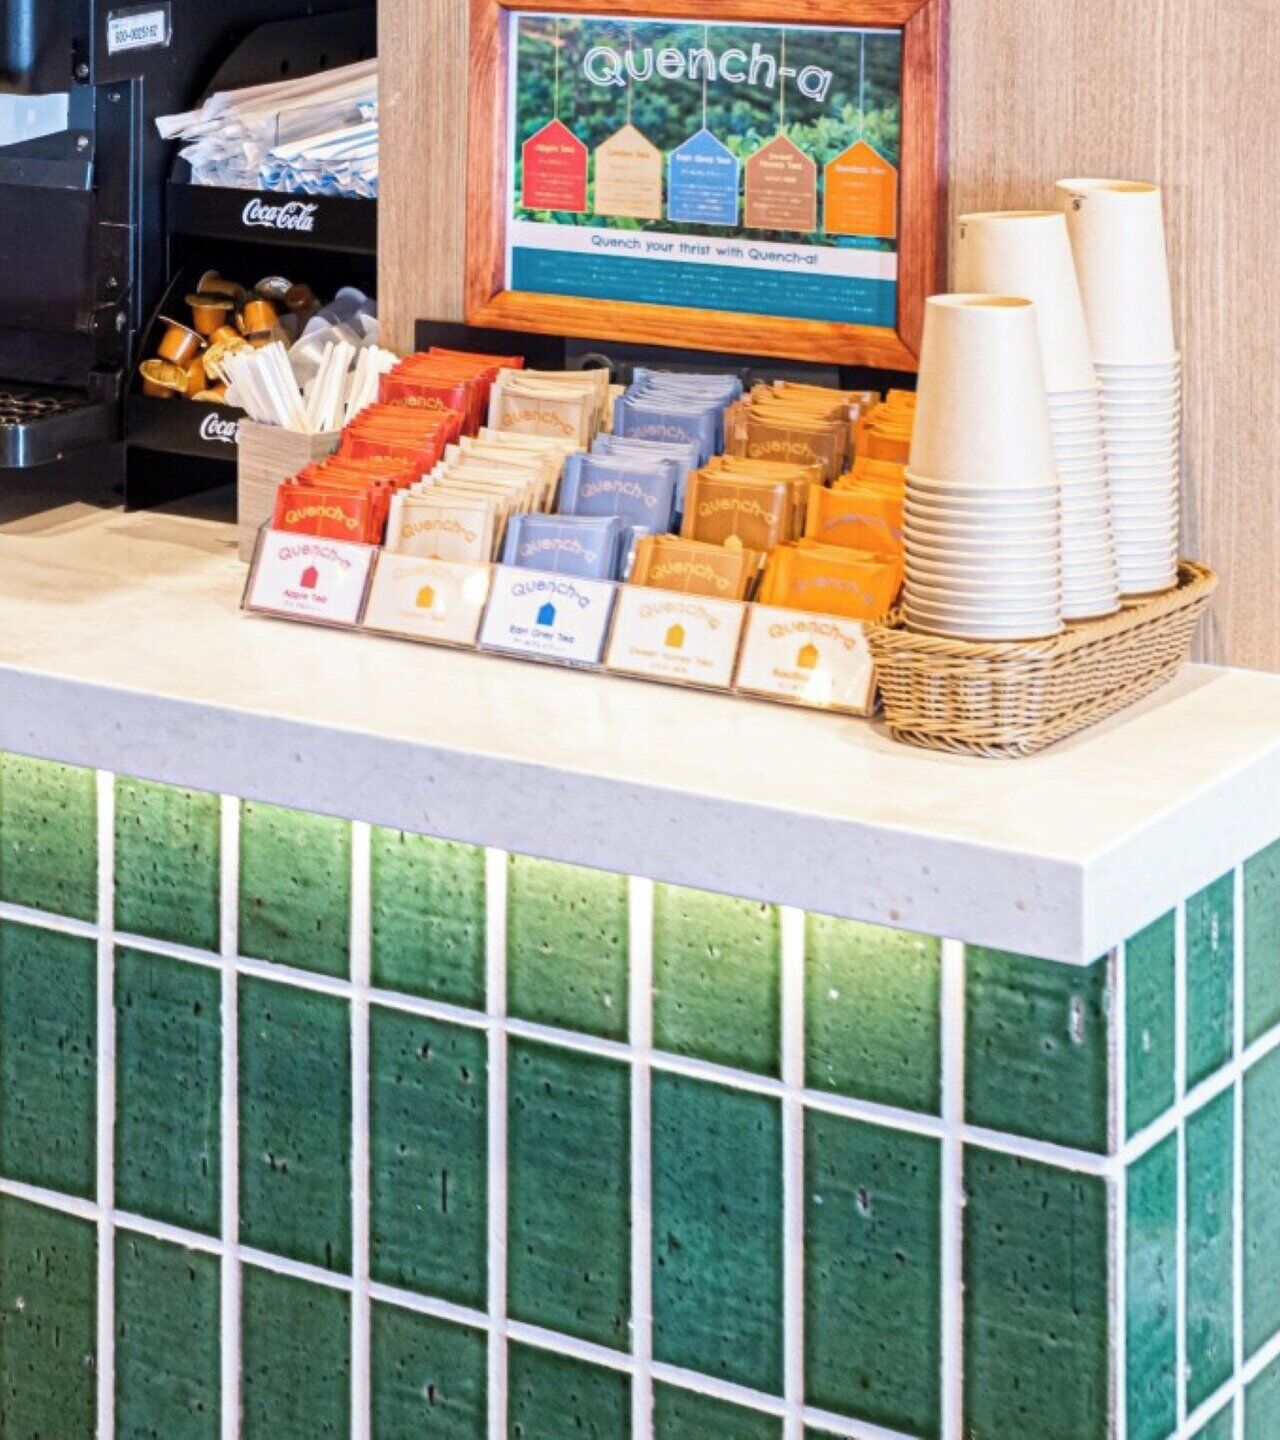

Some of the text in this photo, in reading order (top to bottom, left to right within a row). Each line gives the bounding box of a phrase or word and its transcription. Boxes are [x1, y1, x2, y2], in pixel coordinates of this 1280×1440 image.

[583, 42, 834, 103] Quench-a
[242, 197, 319, 232] Coca-Cola
[591, 234, 642, 250] Quench
[646, 240, 674, 253] your
[716, 245, 744, 259] with
